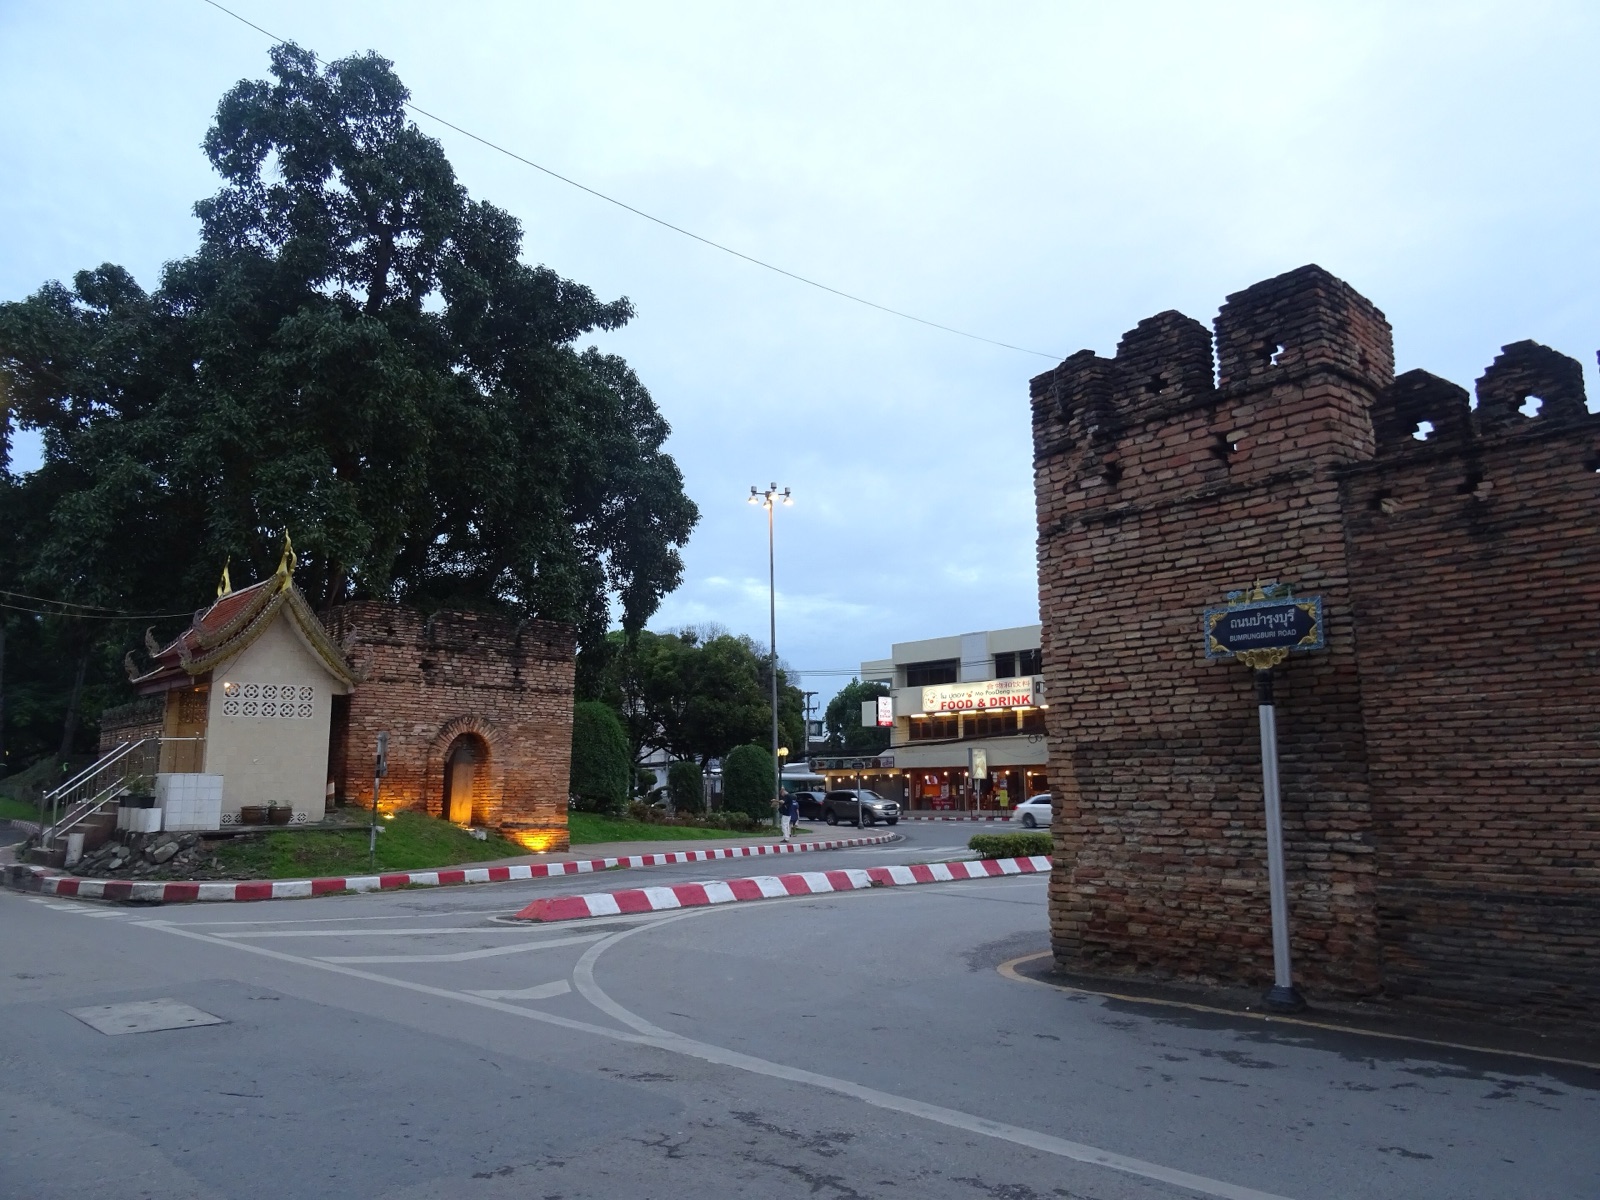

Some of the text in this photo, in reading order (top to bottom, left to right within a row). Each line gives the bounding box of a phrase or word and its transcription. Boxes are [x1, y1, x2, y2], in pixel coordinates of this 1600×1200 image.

[1230, 608, 1295, 629] ถนนบำรุงบุรี
[1229, 629, 1297, 642] BUMRUNGBURI ROAD
[941, 694, 1031, 710] FOOD & DRINK
